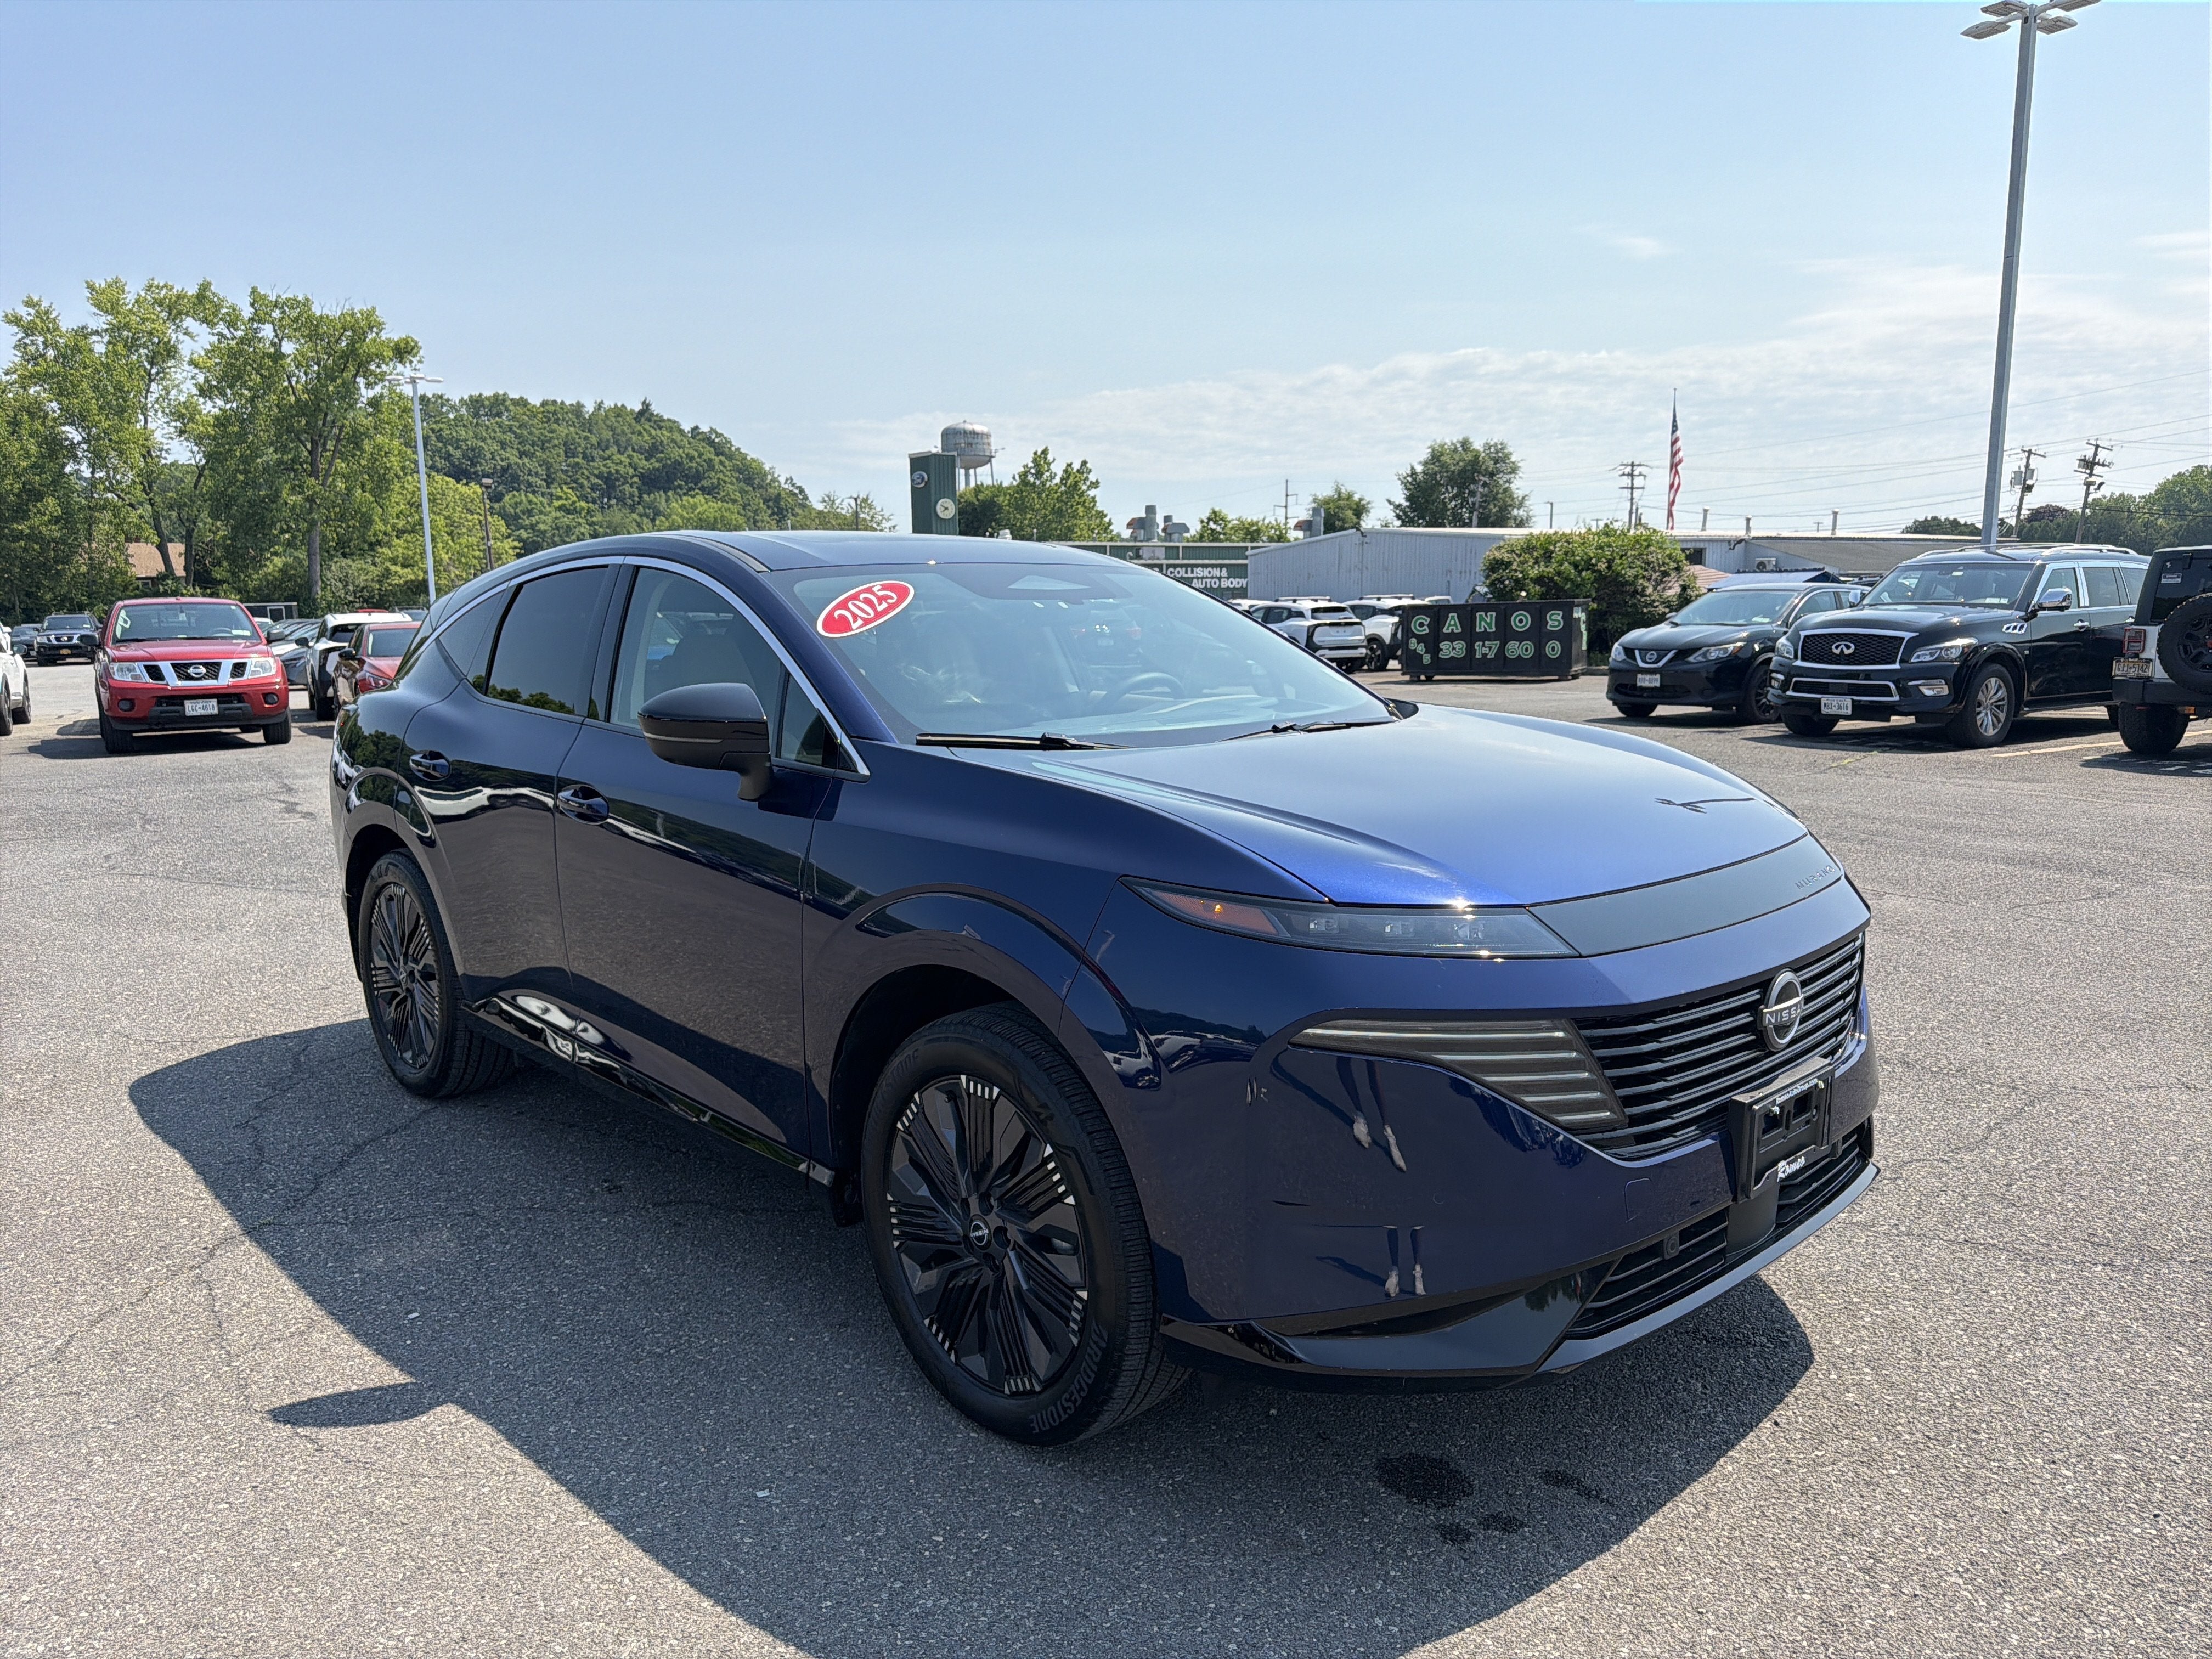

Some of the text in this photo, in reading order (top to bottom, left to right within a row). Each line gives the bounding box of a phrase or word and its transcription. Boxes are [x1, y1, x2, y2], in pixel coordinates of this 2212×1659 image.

[1167, 567, 1220, 577] COLLISION
[1221, 567, 1228, 577] &
[1191, 578, 1248, 588] AUTO BODY
[833, 584, 898, 630] 2025
[1411, 610, 1564, 635] CANOS
[1795, 865, 1835, 889] MURANO
[1777, 1156, 1805, 1182] Romeo
[1029, 1316, 1108, 1434] BRIDGESTONE
